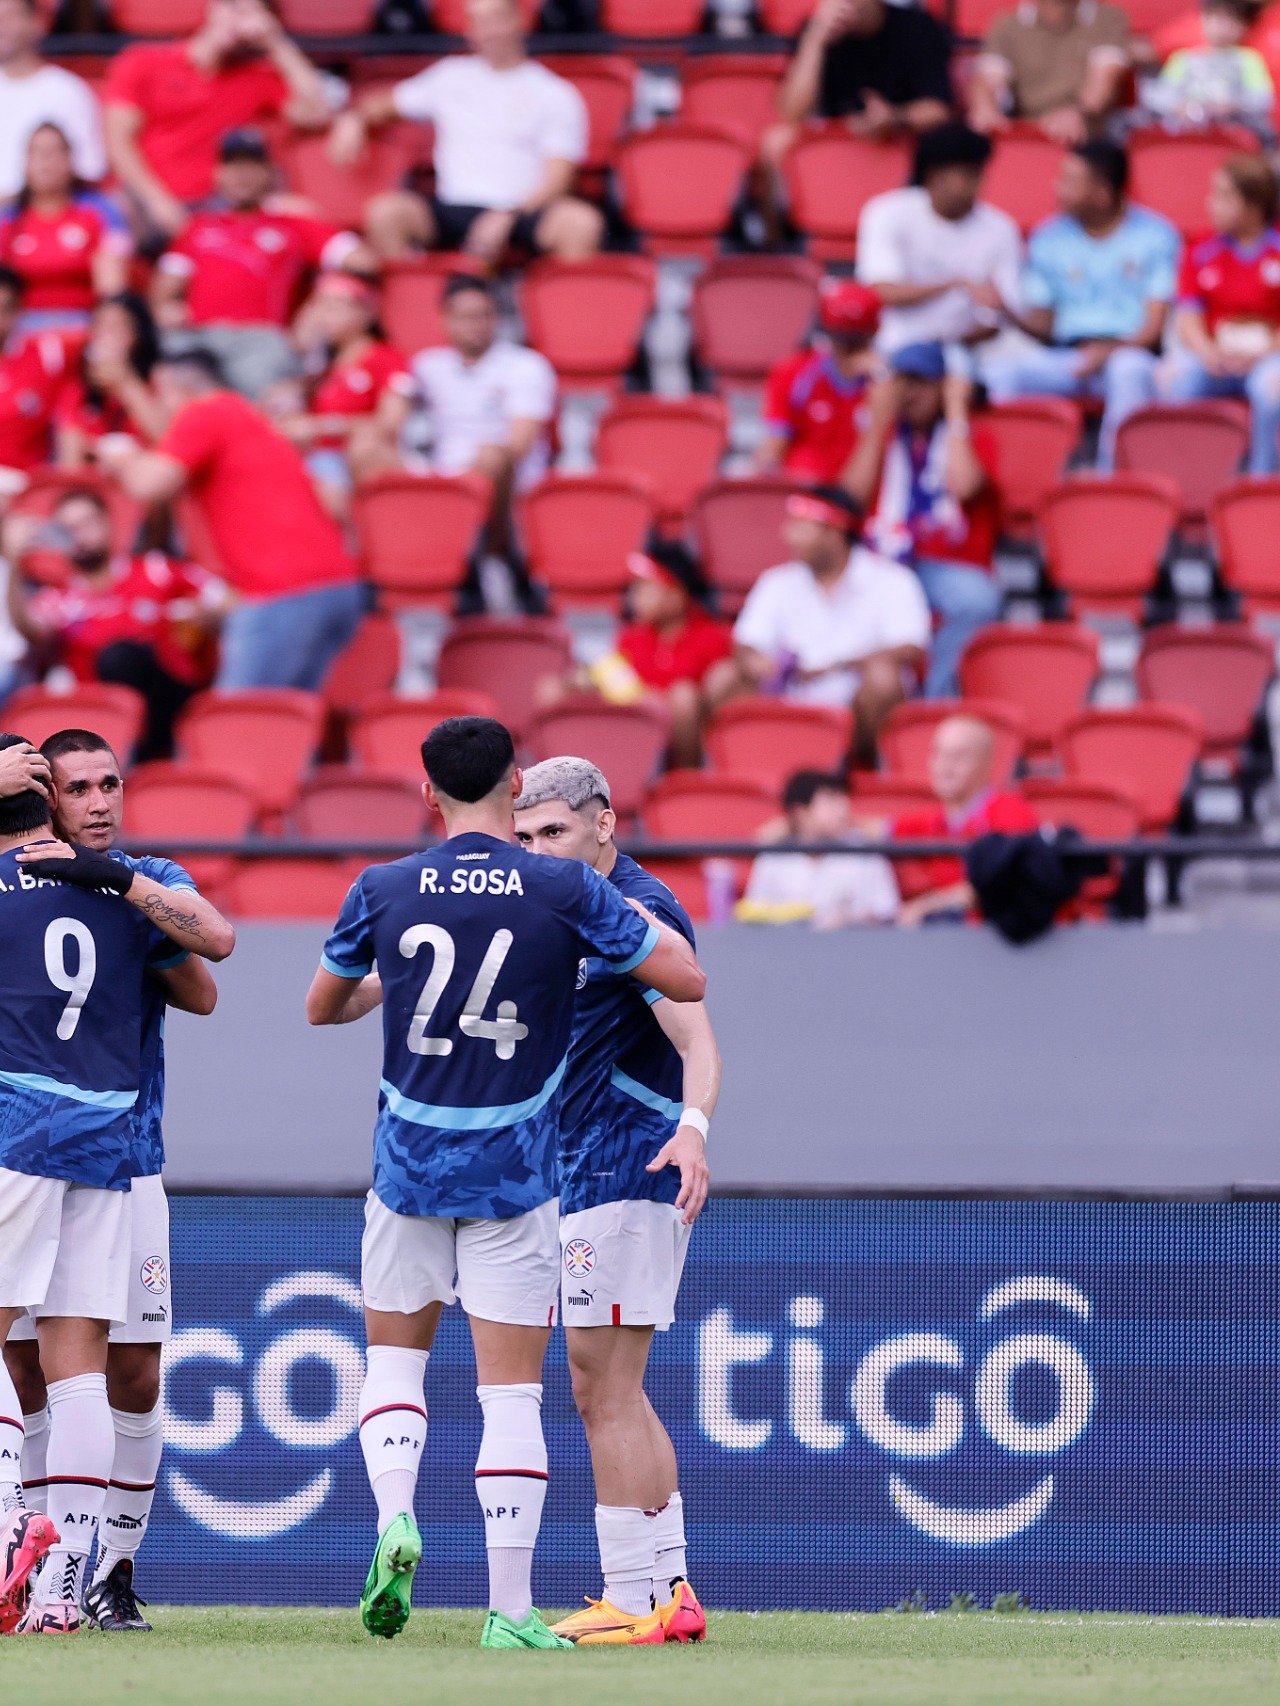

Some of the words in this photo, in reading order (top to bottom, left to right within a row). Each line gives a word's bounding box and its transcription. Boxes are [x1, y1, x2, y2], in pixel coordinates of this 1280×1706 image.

[456, 853, 490, 861] PARAGUAY
[419, 867, 445, 894] R.
[450, 868, 524, 896] SOSA
[44, 917, 96, 1041] 9
[398, 923, 529, 1060] 24
[568, 1296, 590, 1306] PUMA
[142, 1312, 165, 1322] PUMA
[383, 1436, 420, 1450] APF
[1, 1448, 21, 1462] AP
[64, 1512, 98, 1527] APF
[486, 1506, 521, 1519] APF
[106, 1516, 137, 1530] PUMA
